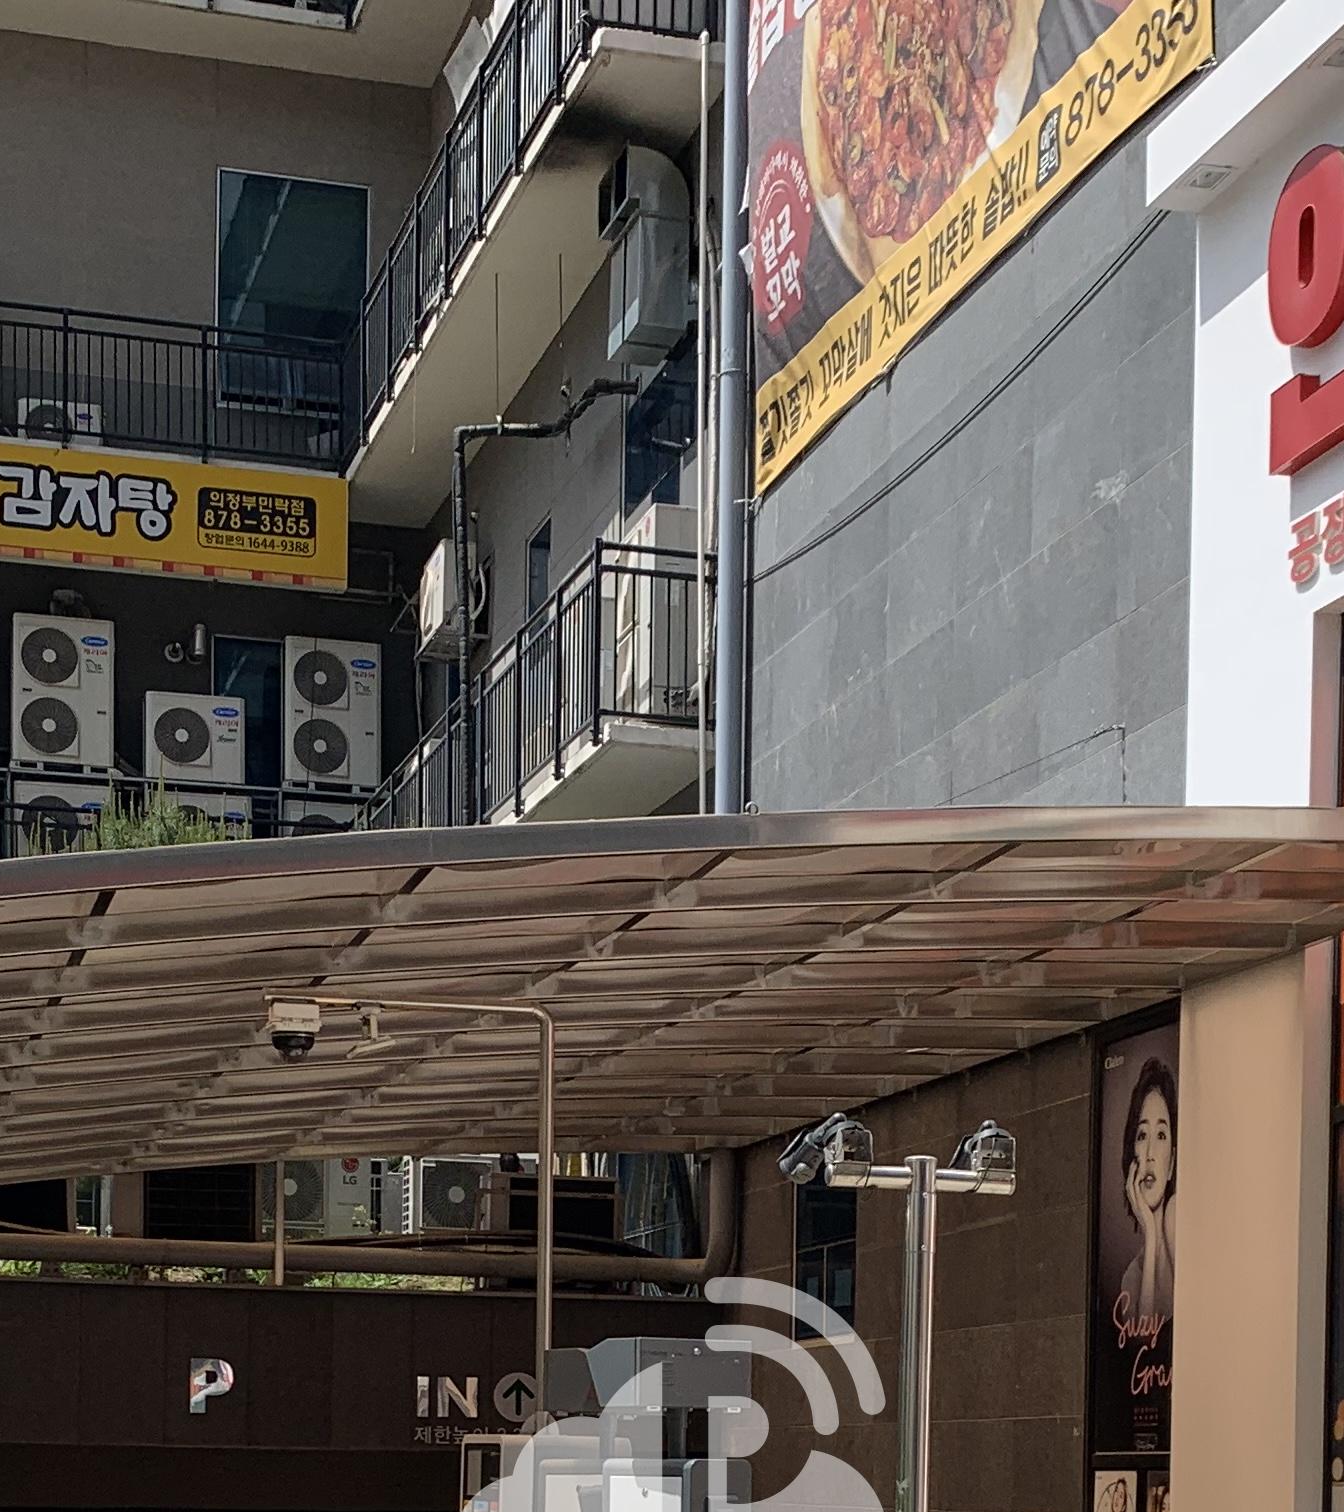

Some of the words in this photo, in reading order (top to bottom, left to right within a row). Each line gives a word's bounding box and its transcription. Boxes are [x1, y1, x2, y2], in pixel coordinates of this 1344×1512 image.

[927, 195, 977, 297] 따뜻한
[209, 490, 305, 517] 의정부민락점
[203, 509, 310, 535] 878-3355
[247, 536, 310, 554] 1644-9388
[342, 1174, 358, 1186] LG
[1112, 1290, 1166, 1350] Suzy
[189, 1357, 235, 1414] P
[415, 1375, 479, 1419] IN
